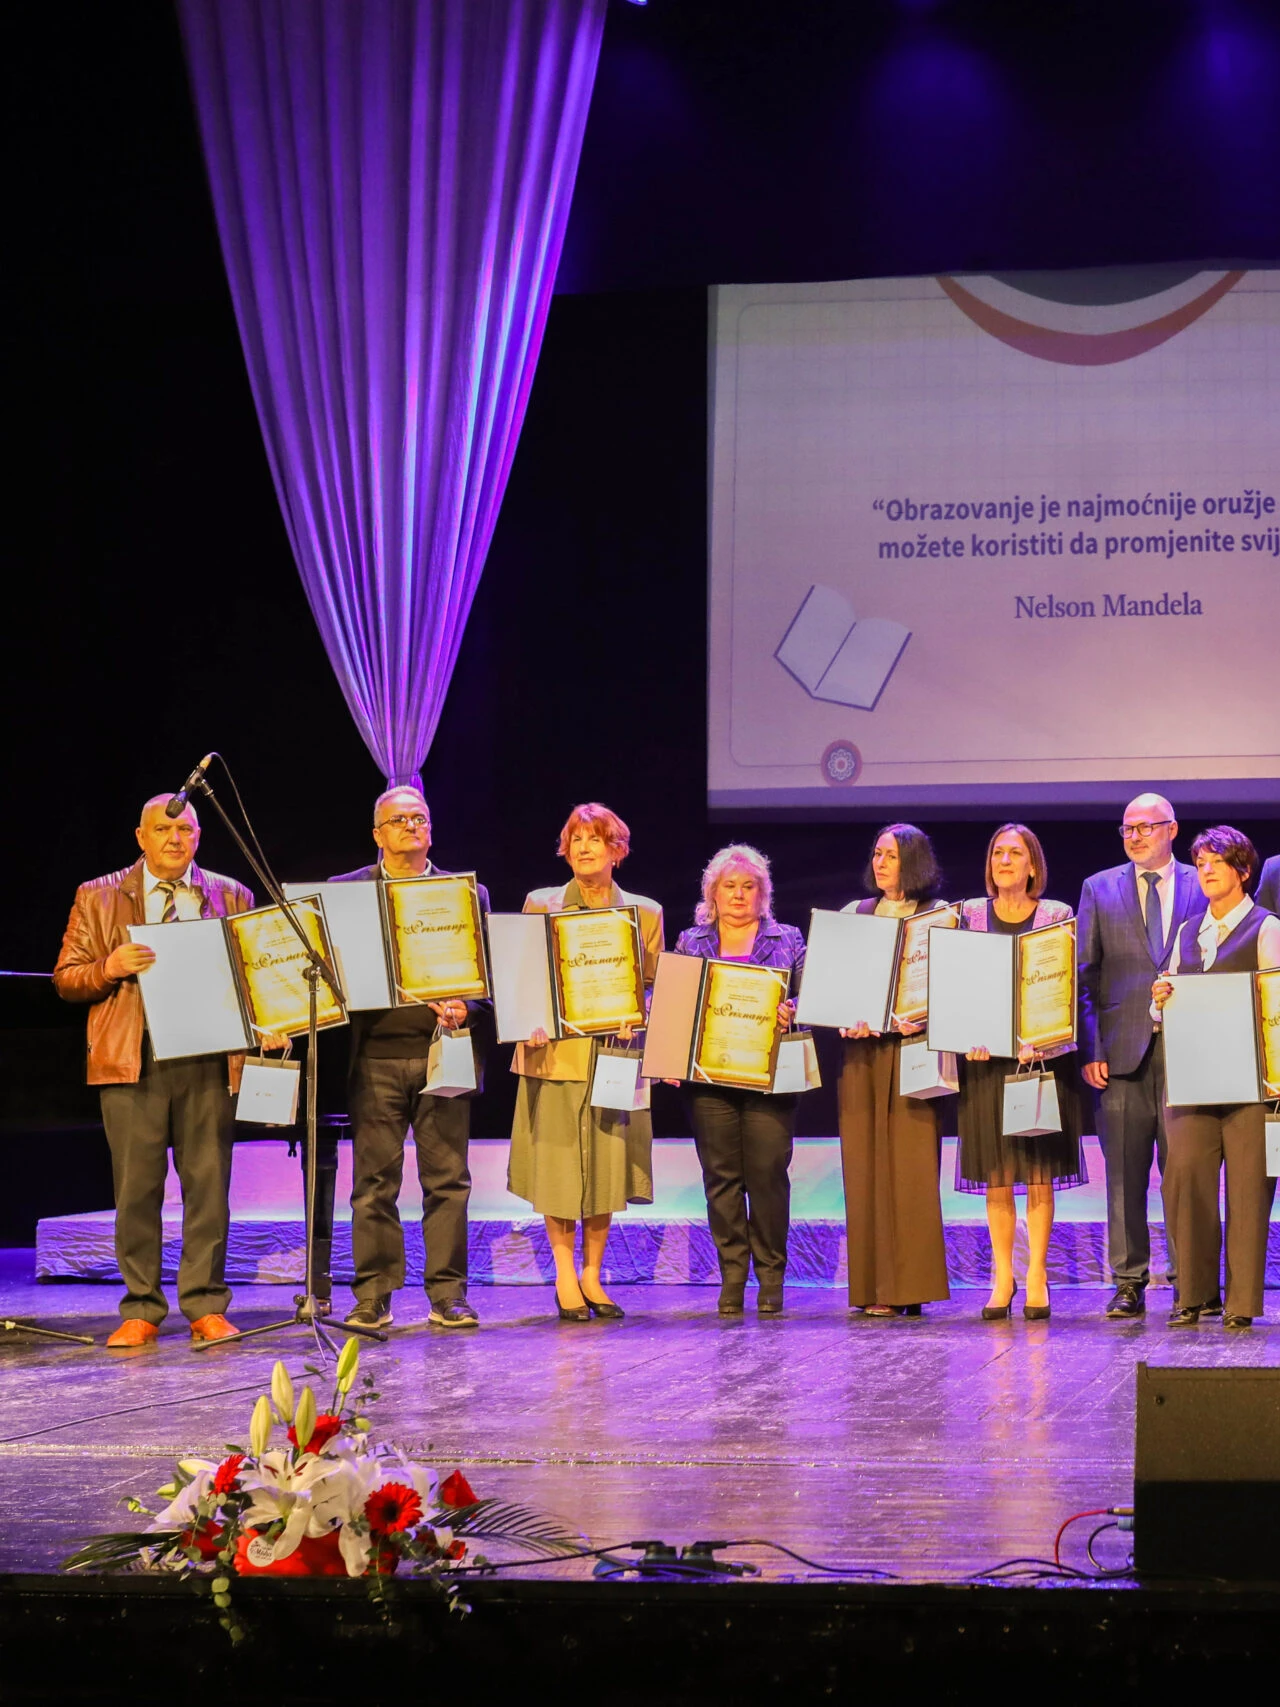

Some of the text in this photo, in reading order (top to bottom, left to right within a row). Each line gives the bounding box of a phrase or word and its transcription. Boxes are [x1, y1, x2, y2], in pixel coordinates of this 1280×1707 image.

[872, 495, 1034, 525] “Obrazovanje
[1038, 494, 1061, 524] je
[1067, 492, 1197, 523] najmoćnije
[1202, 489, 1276, 519] oružje
[878, 533, 965, 559] možete
[971, 531, 1063, 557] koristiti
[1069, 531, 1098, 555] da
[1105, 528, 1235, 559] promjenite
[1014, 592, 1203, 619] Nelson Mandela
